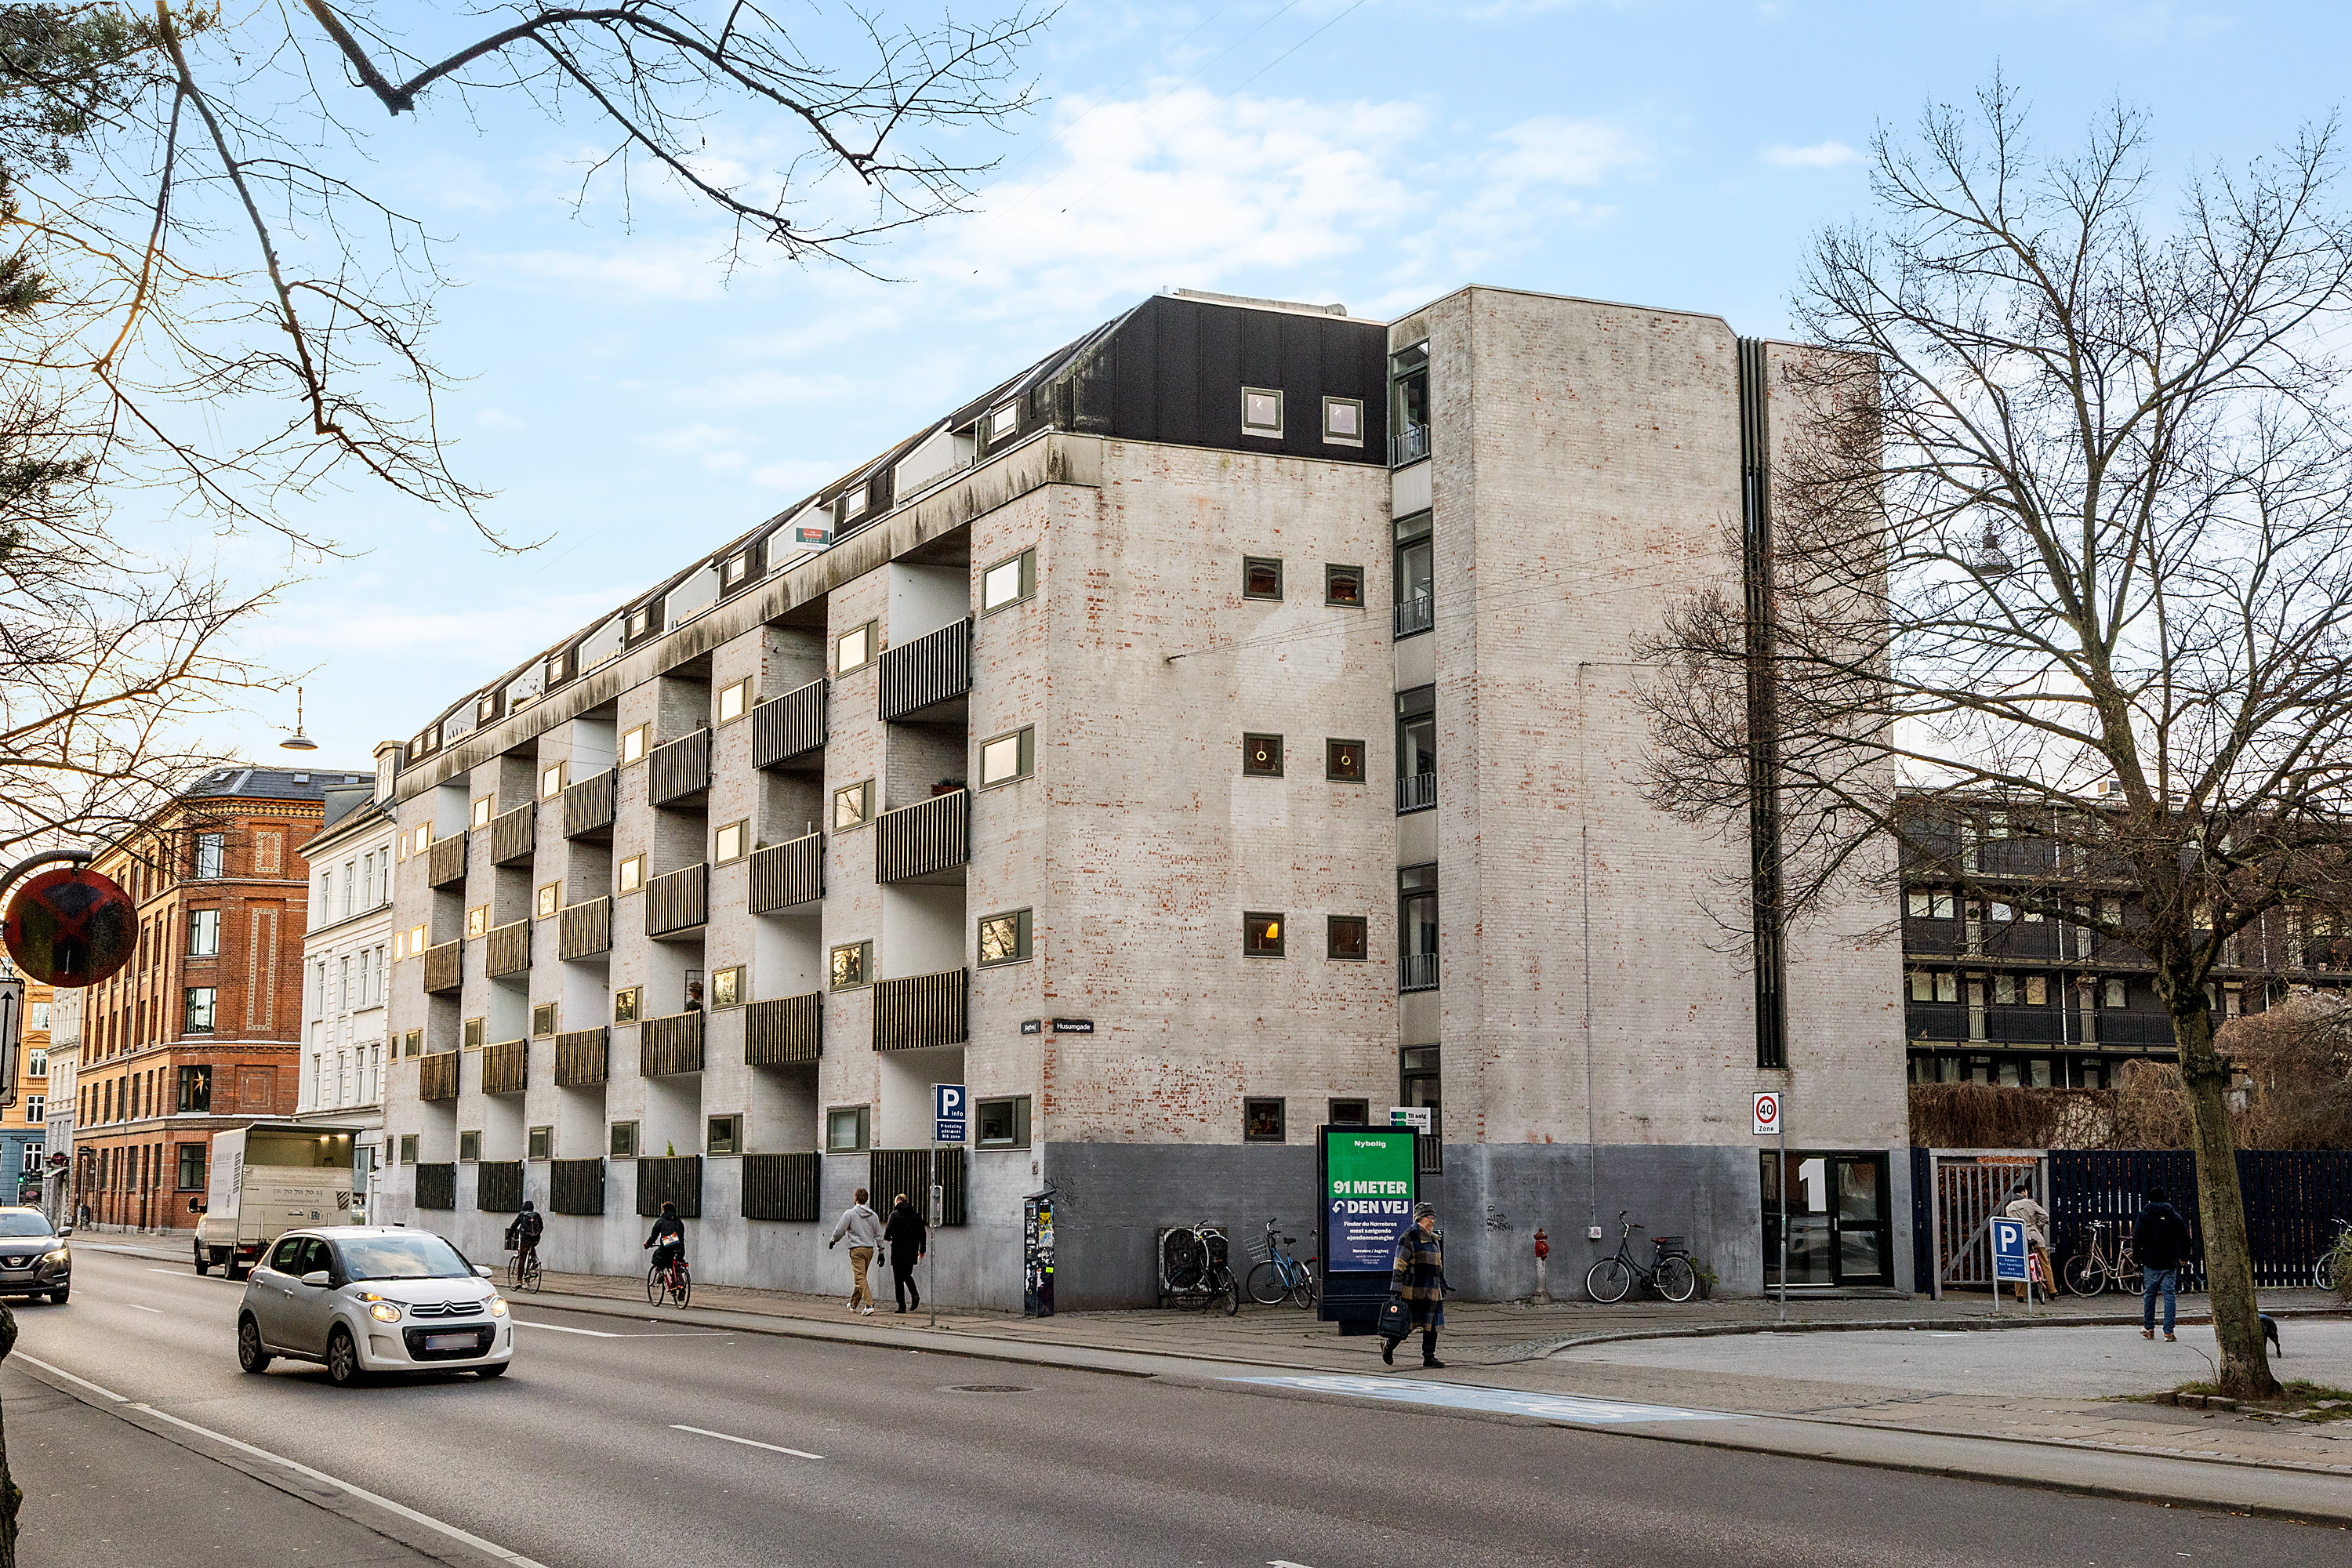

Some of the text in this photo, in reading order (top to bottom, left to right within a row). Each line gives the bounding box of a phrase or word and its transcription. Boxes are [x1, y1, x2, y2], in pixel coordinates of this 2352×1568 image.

[1057, 1022, 1091, 1031] Husumgade
[943, 1089, 960, 1116] P
[1759, 1104, 1773, 1115] 40
[1354, 1140, 1387, 1149] Nybolig
[1333, 1180, 1407, 1195] 91 METER
[1799, 1158, 1827, 1212] 1
[1347, 1200, 1409, 1214] DEN VEJ
[2001, 1225, 2016, 1252] P
